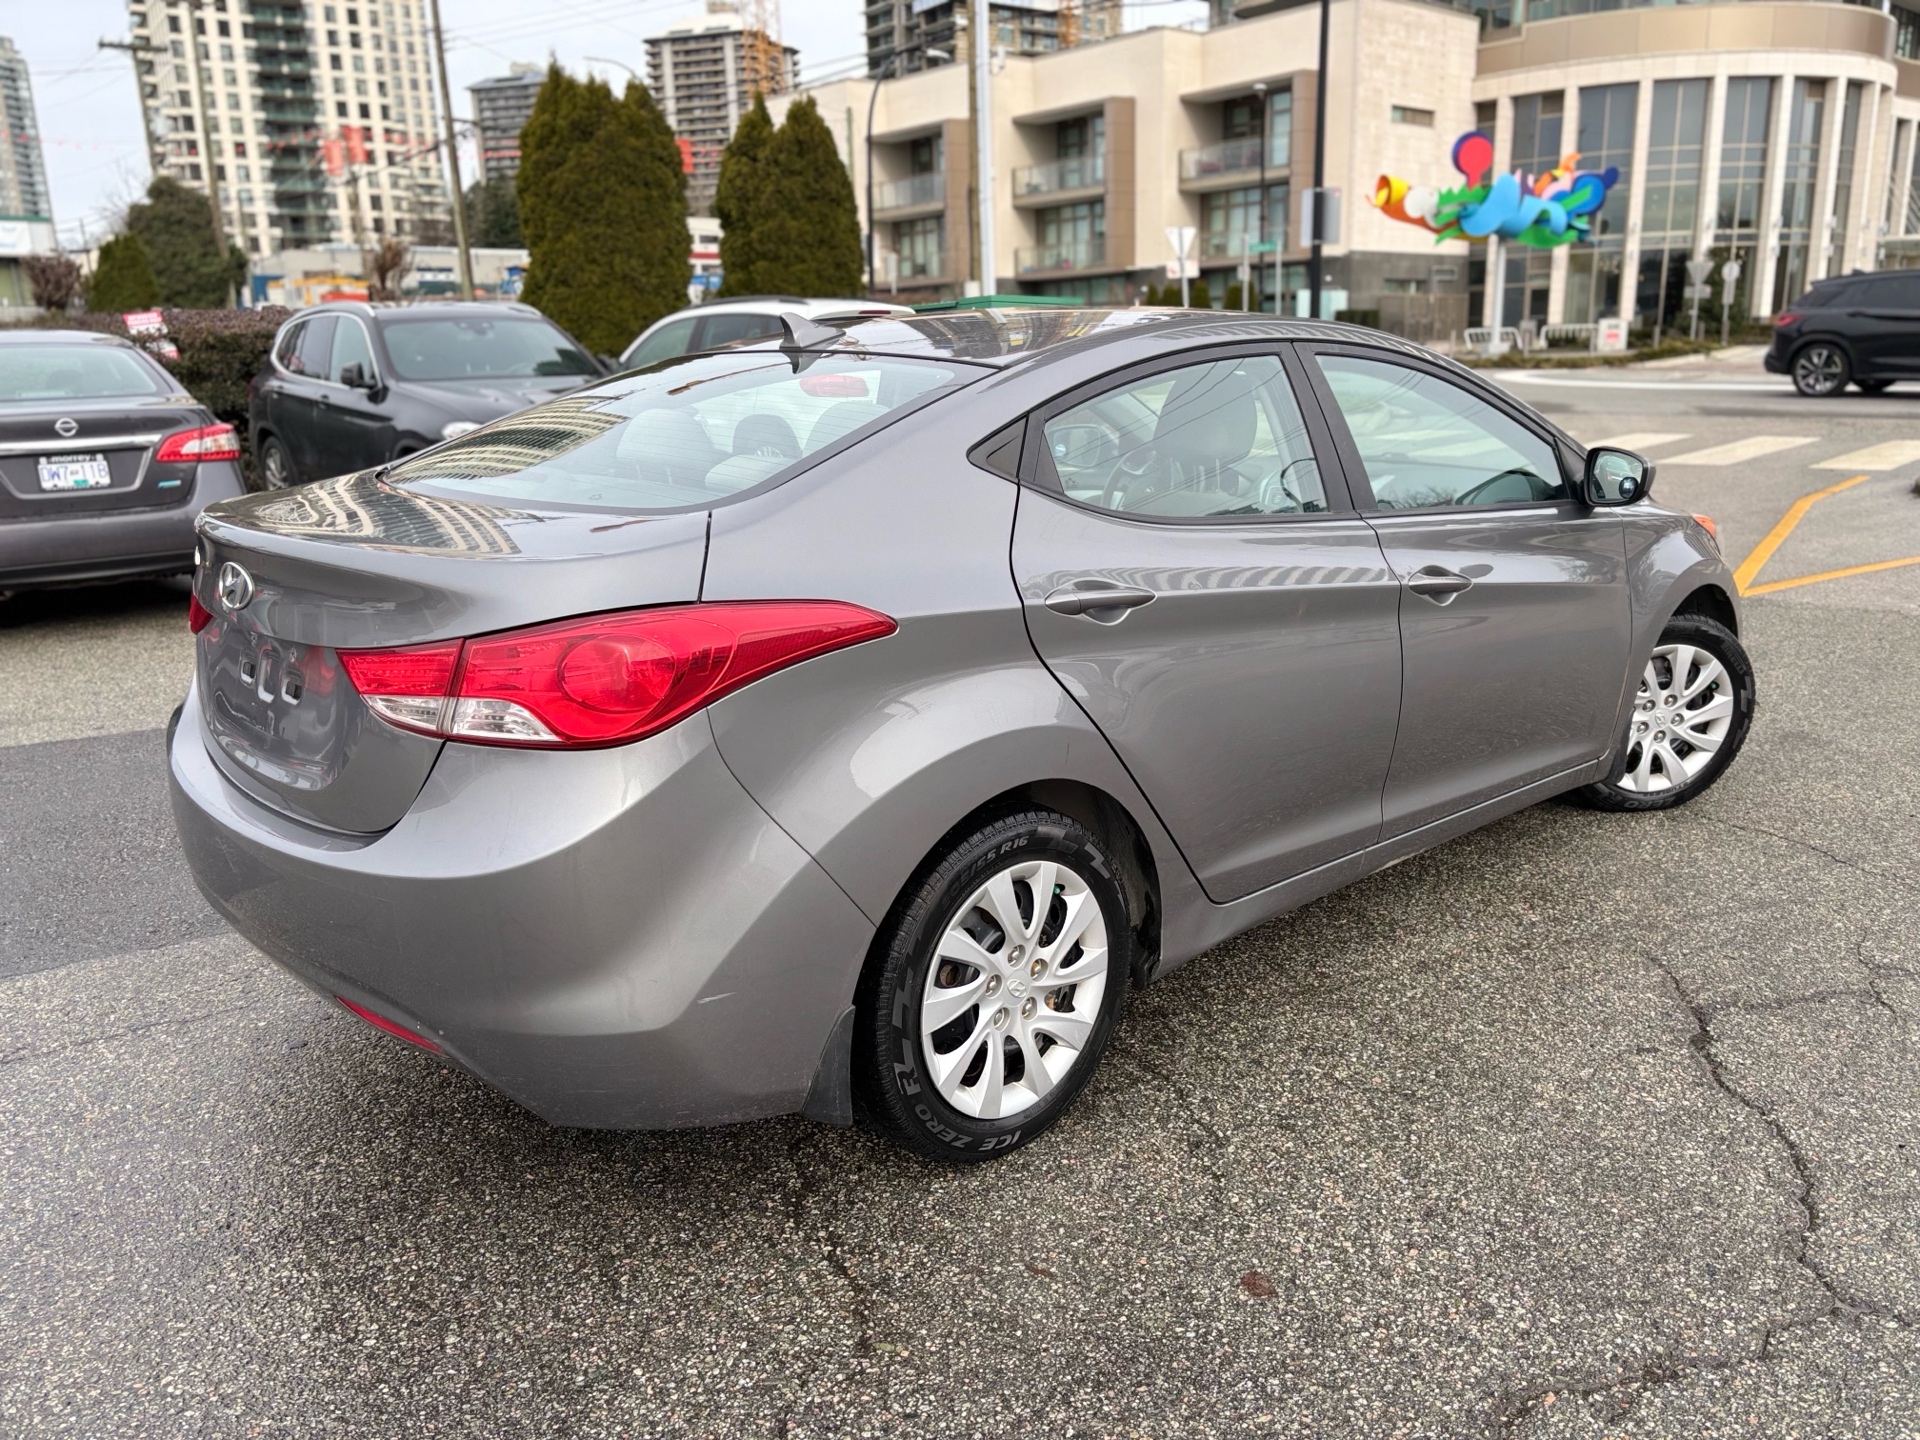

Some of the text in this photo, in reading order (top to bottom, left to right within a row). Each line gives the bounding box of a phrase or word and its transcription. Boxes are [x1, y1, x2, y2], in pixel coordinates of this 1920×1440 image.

[1000, 835, 1029, 855] R16
[915, 1103, 973, 1148] ZERO
[979, 1130, 1021, 1151] ICE
